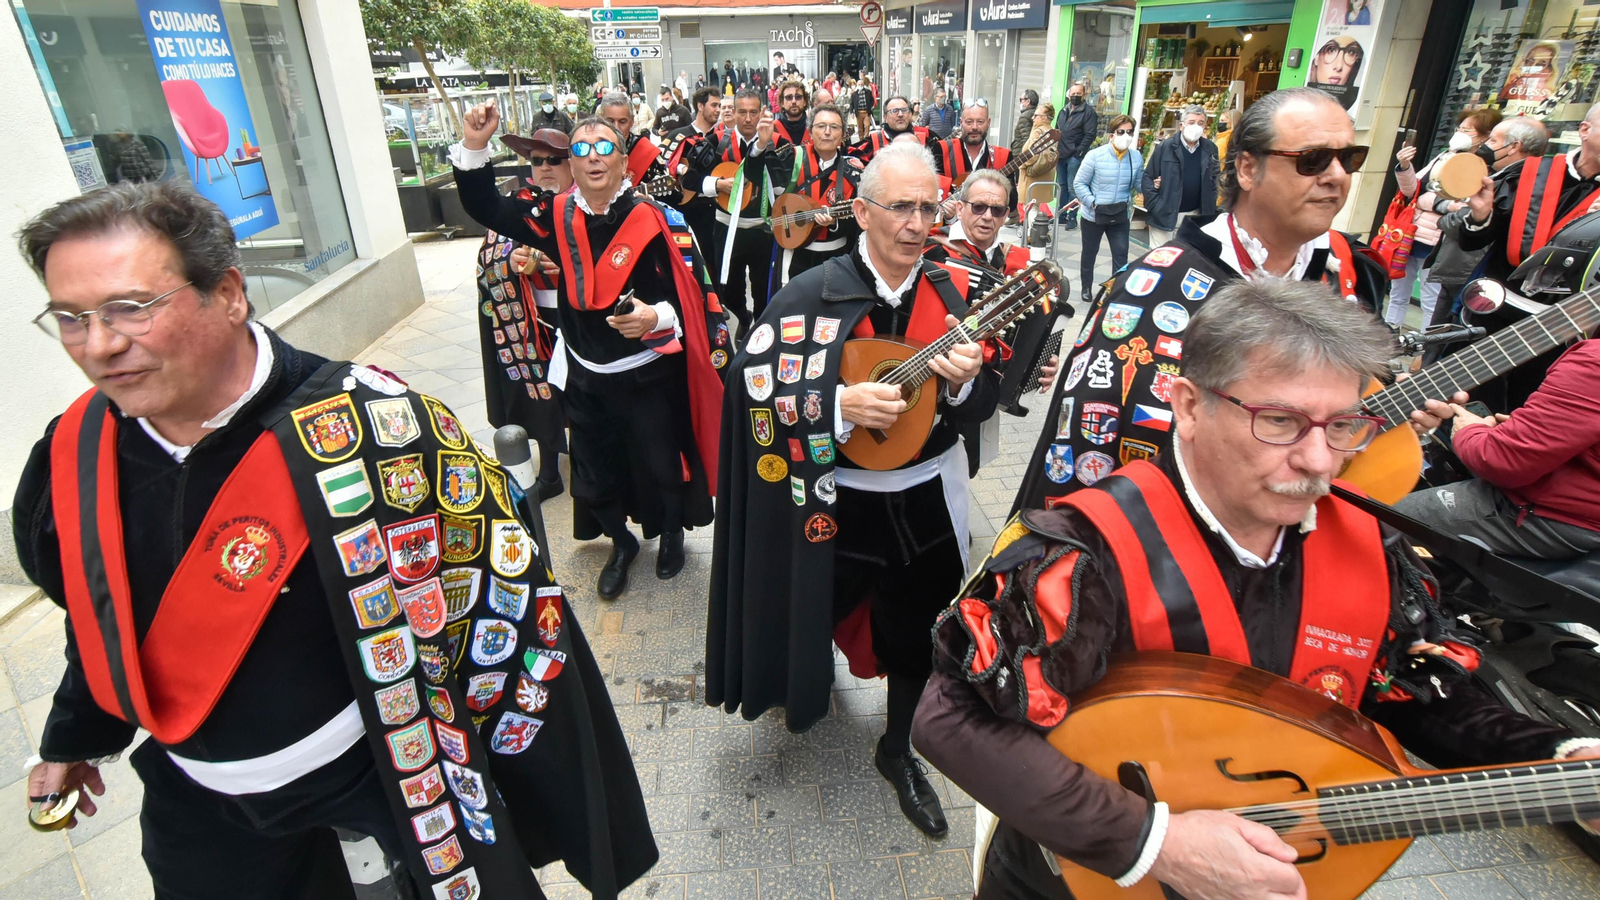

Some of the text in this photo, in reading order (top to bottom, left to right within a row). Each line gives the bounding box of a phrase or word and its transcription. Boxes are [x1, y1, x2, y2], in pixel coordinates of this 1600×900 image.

[928, 9, 940, 26] Aural
[987, 0, 1008, 21] Aural
[149, 10, 221, 33] CUIDAMOS
[153, 37, 231, 57] DE TU CASA
[162, 60, 236, 80] COMO TÚ LO HACES
[414, 77, 429, 88] LA
[1508, 86, 1549, 97] GUESS
[252, 206, 264, 219] AQUÍ
[304, 240, 350, 273] santalucía
[441, 494, 480, 510] SALAMANCA
[390, 520, 432, 537] ÖSTERREICH
[205, 516, 287, 583] TUNA DE PERITOS INDUSTRIALES
[444, 552, 473, 561] BURGOS
[213, 573, 246, 592] SEVILLA
[1304, 624, 1352, 645] INMACULADA
[1303, 636, 1369, 659] BECA DE HONOR
[471, 672, 506, 681] CANTABRIA
